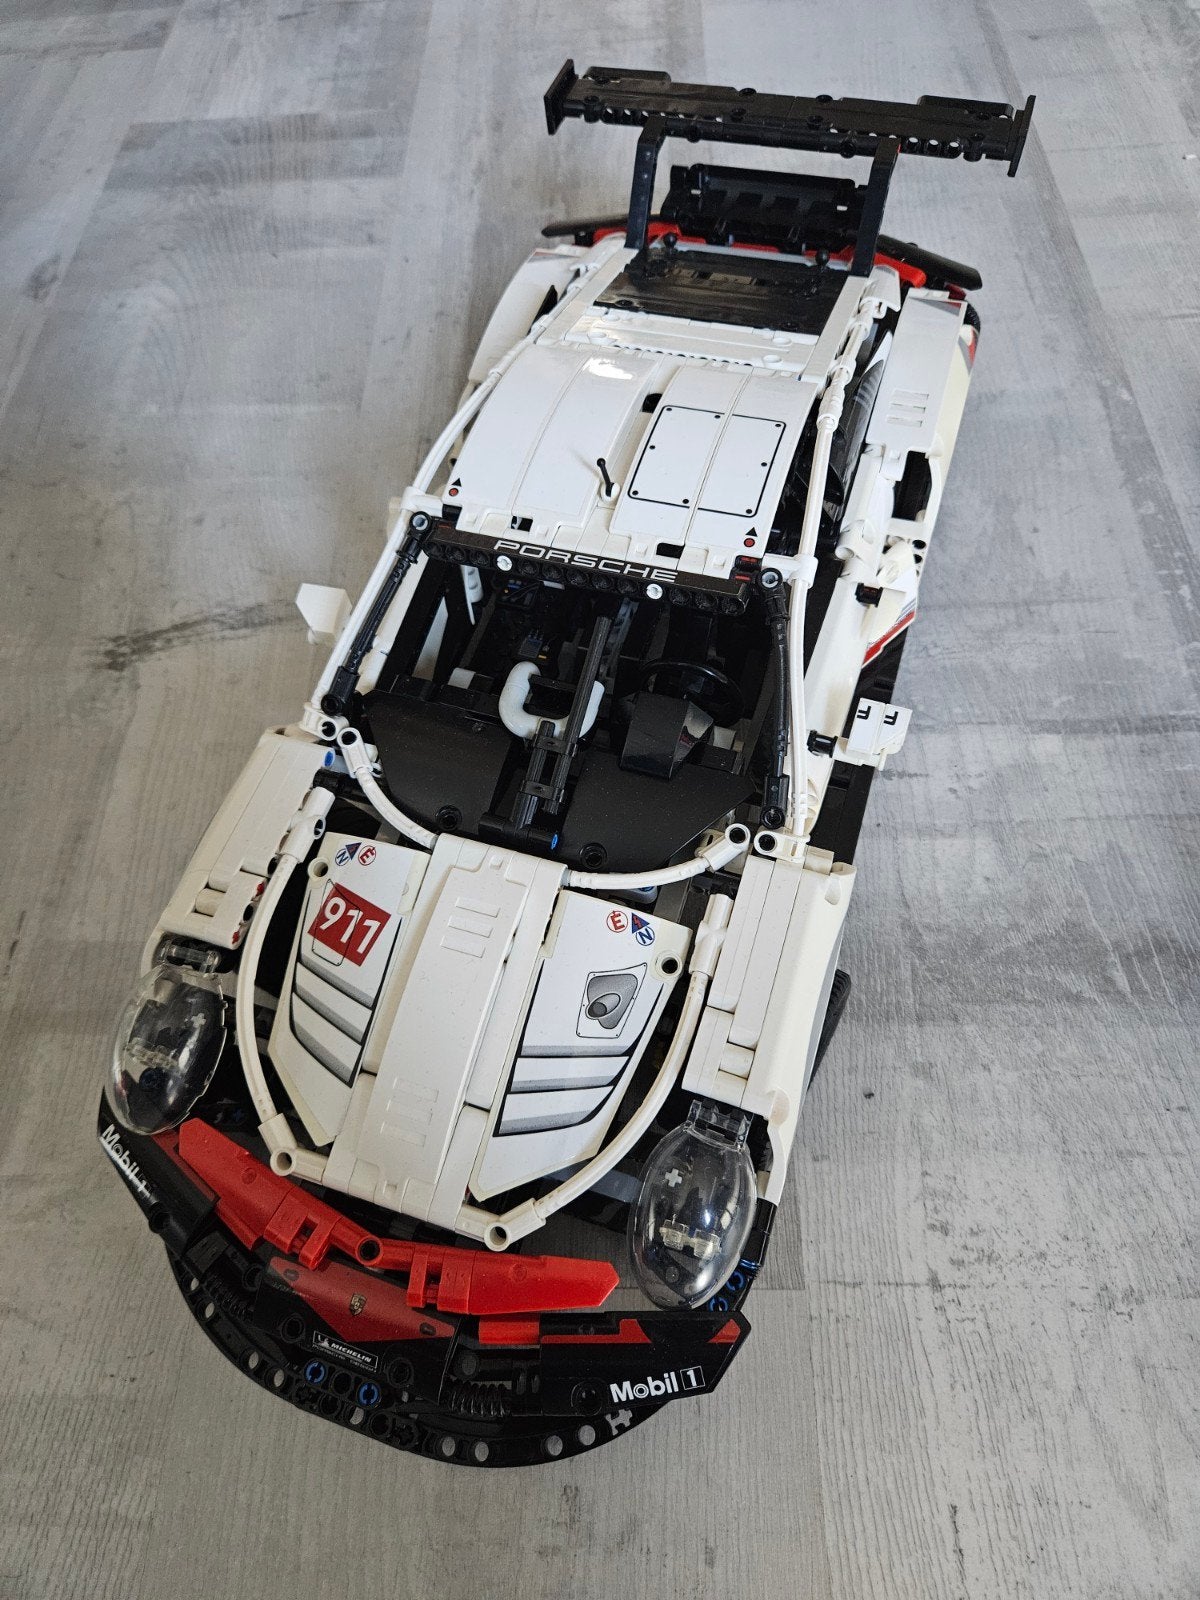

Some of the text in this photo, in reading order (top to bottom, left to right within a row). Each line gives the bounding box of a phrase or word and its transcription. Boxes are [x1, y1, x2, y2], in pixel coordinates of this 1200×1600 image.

[493, 540, 679, 583] PORSCHE
[319, 896, 381, 954] 911
[610, 910, 626, 931] E
[637, 927, 653, 945] N
[100, 1123, 140, 1180] Mobil
[331, 1342, 373, 1363] MICHELIN
[609, 1369, 698, 1403] Mobil 1
